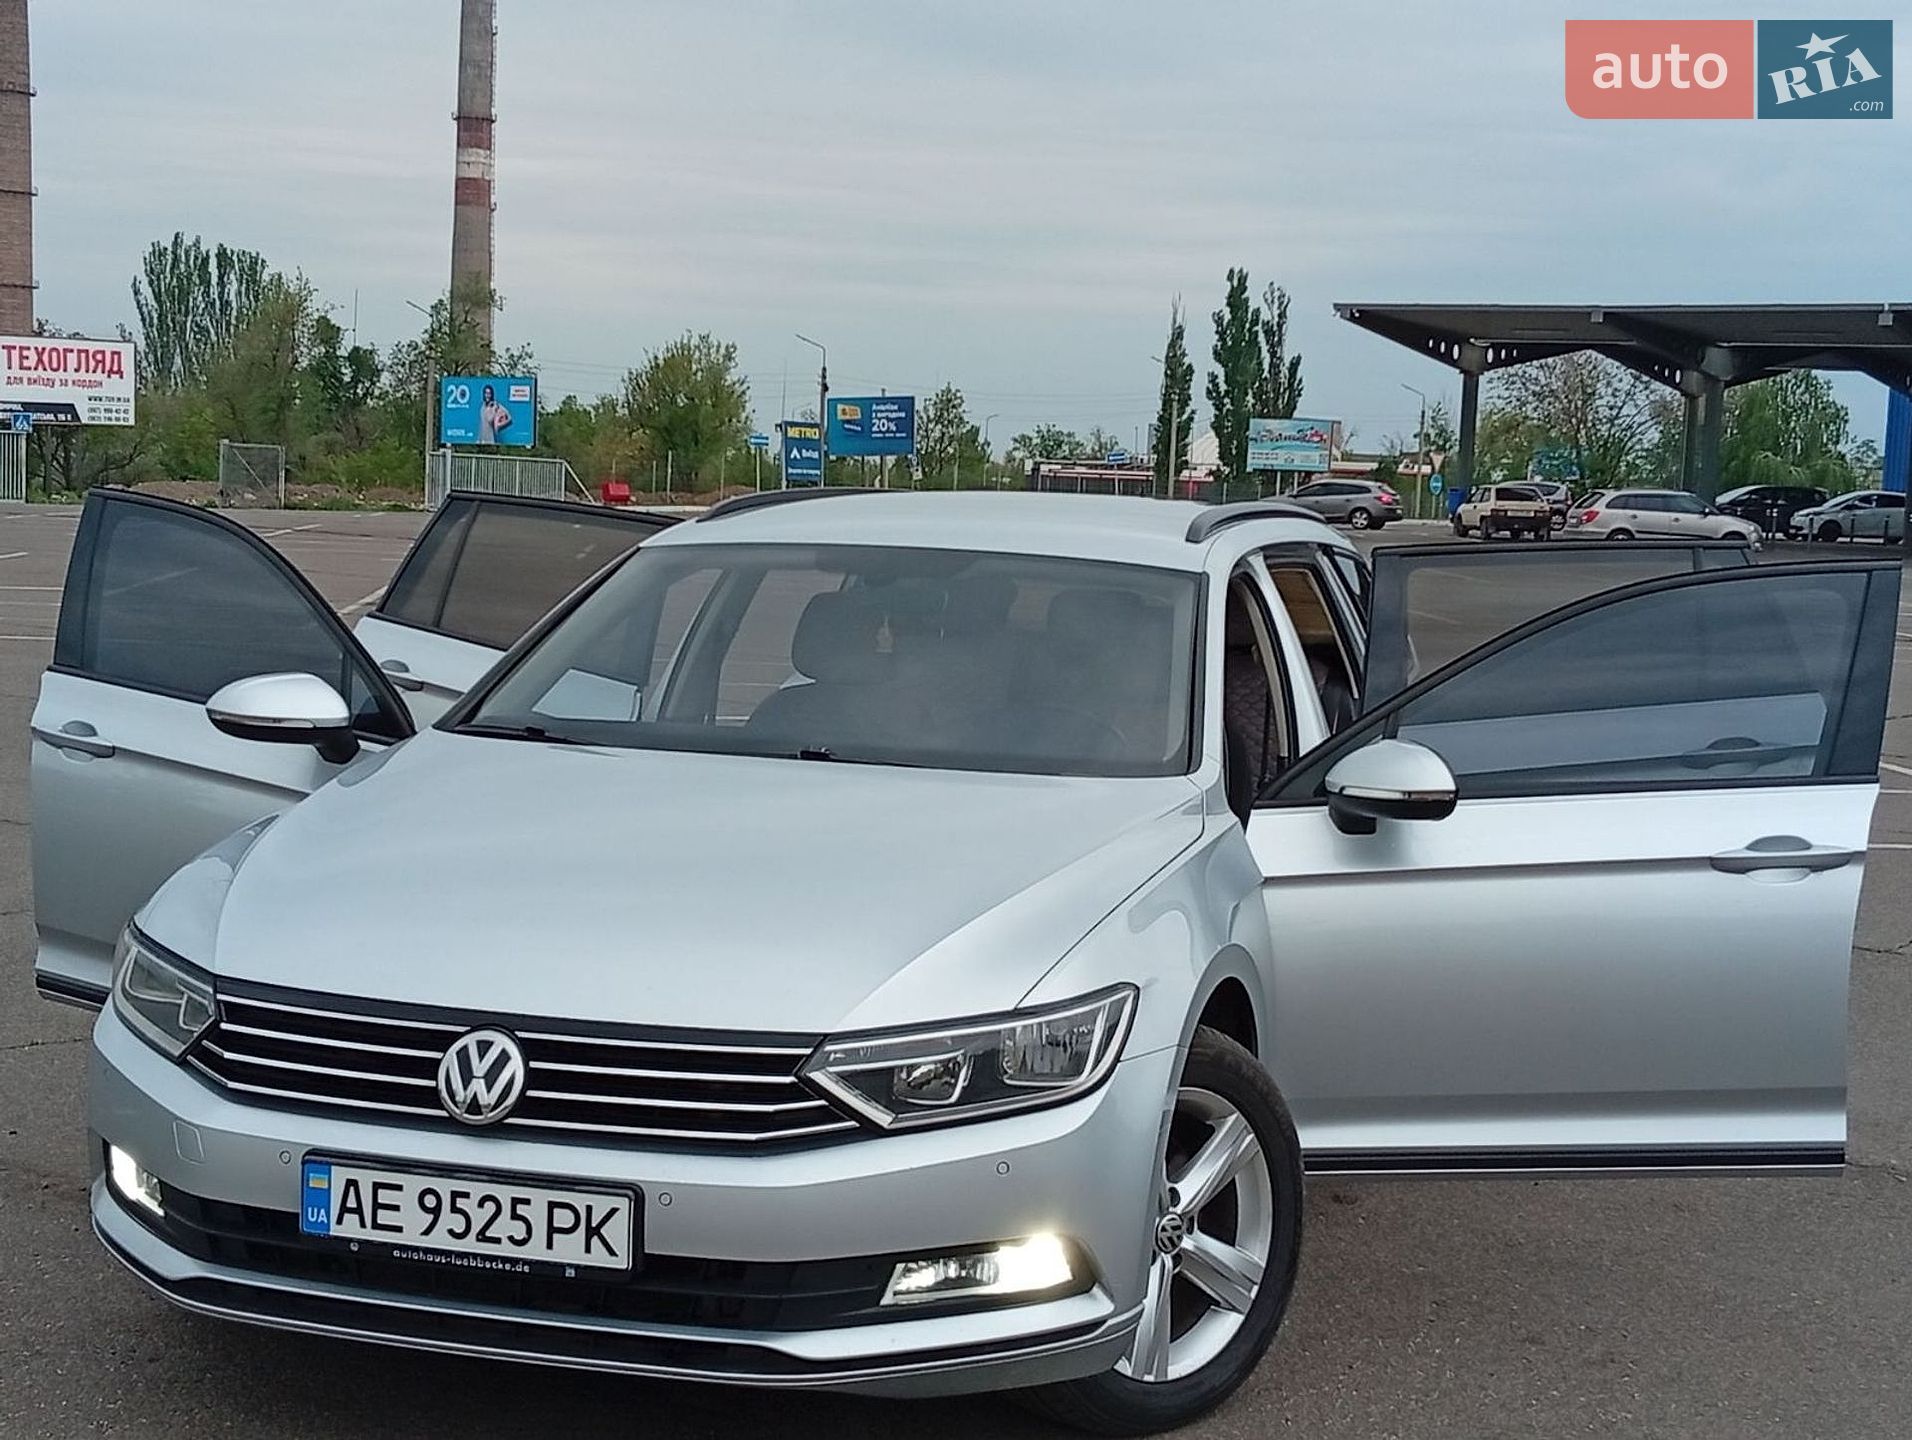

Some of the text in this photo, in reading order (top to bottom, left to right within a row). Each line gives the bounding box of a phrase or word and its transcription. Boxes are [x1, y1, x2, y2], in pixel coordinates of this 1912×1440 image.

[1, 344, 124, 380] ТЕХОГЛЯД
[6, 375, 103, 390] для виїзду за кордон
[787, 426, 819, 440] METRO
[871, 418, 897, 432] 20%
[307, 1205, 328, 1225] UA
[335, 1177, 621, 1258] AE 9525 PK
